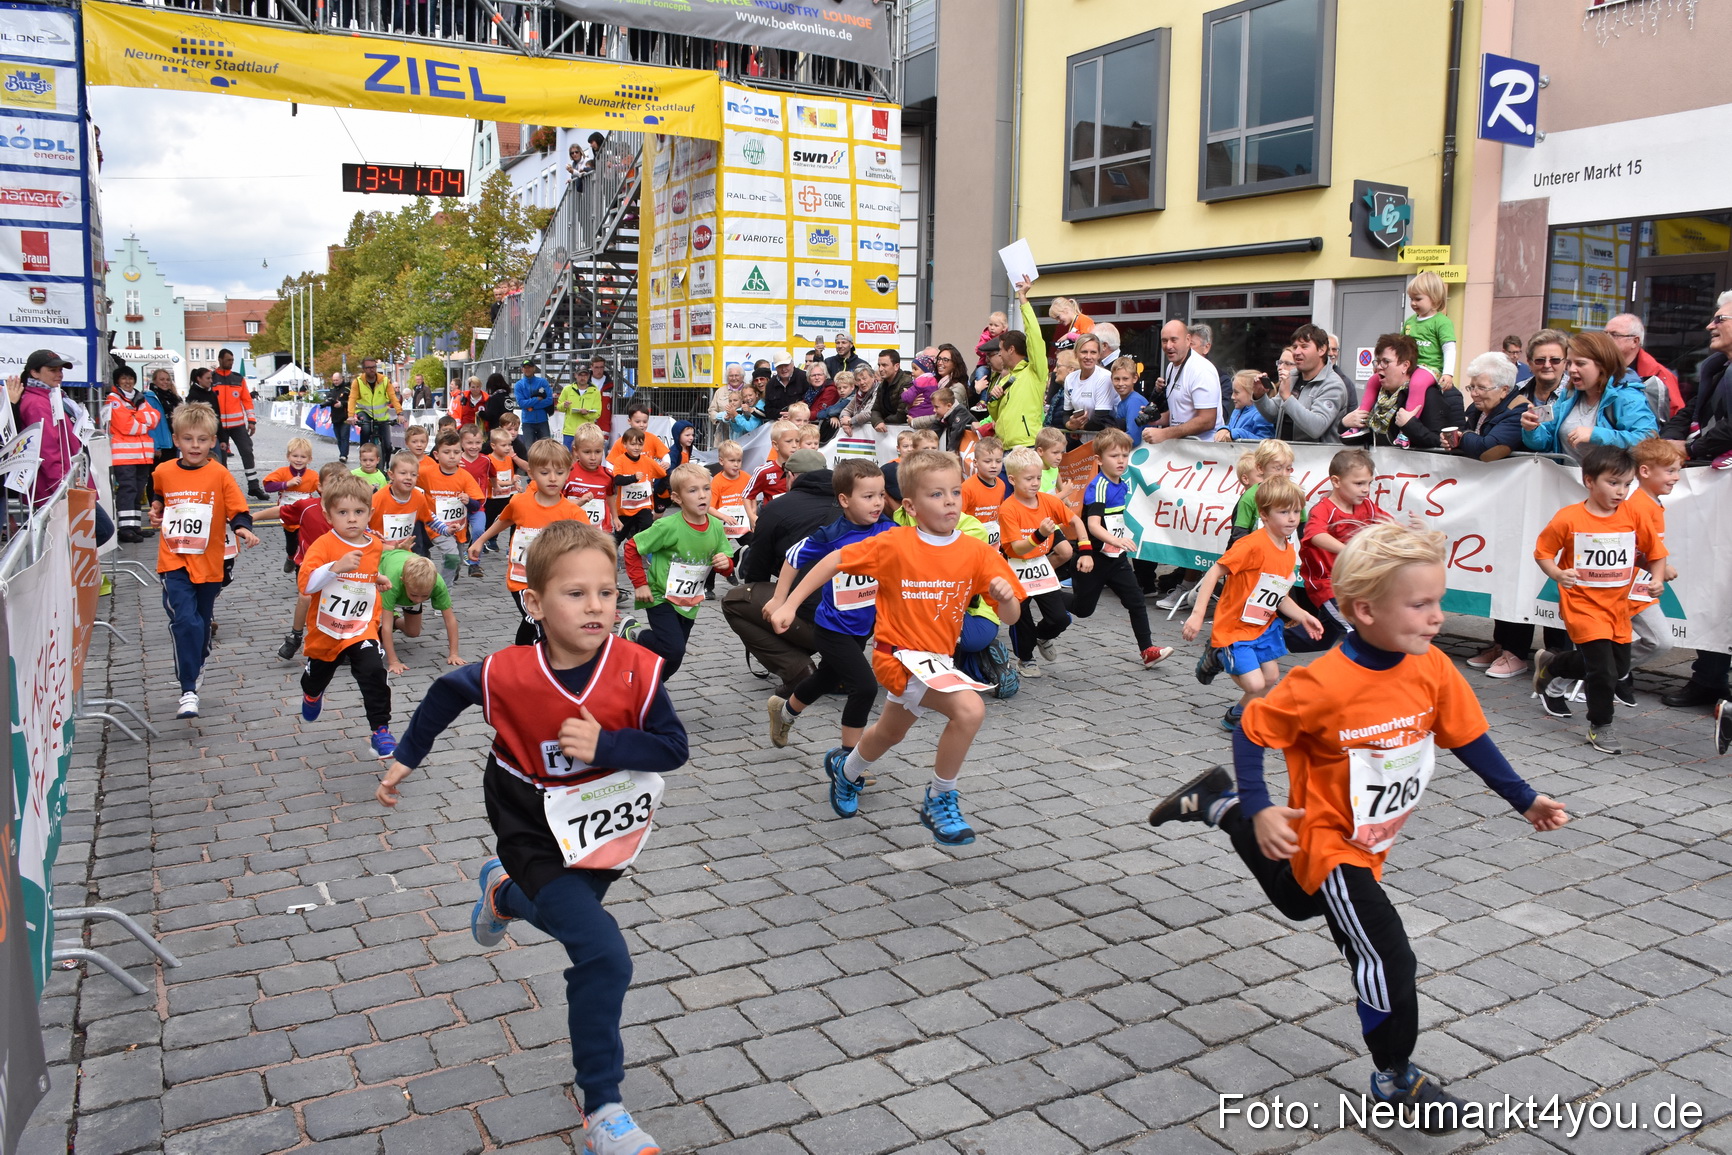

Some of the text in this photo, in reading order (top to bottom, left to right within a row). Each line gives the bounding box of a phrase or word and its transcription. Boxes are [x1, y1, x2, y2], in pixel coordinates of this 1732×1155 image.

[653, 1, 692, 12] concepts
[755, 0, 819, 18] INDUSTRY
[823, 9, 873, 30] LOUNGE
[736, 11, 853, 41] www.bockonline.de
[124, 47, 280, 75] Neumarkter Stadtlauf
[364, 52, 506, 104] ZIEL
[578, 94, 696, 113] Neumarkter Stadtlauf
[755, 117, 780, 125] energie
[33, 151, 75, 162] energie
[1533, 159, 1643, 188] Unterer Markt 15
[824, 193, 842, 201] CODE
[824, 200, 846, 209] CLINIC
[742, 235, 784, 245] VARIOTEC
[22, 252, 48, 265] Braun
[17, 306, 62, 316] Neumarkter
[9, 313, 70, 325] Lammsbräu
[134, 351, 170, 362] Laufsport
[626, 491, 648, 500] 7254
[169, 518, 203, 535] 7169
[1584, 549, 1628, 567] 7004
[1016, 563, 1050, 581] 7030
[901, 579, 956, 588] Neumarkter
[858, 589, 877, 599] Anton
[901, 590, 944, 601] Stadtlauf
[329, 594, 368, 618] 7149
[1534, 605, 1555, 619] Jura
[1338, 714, 1417, 742] Neumarkter
[568, 792, 652, 849] 7233
